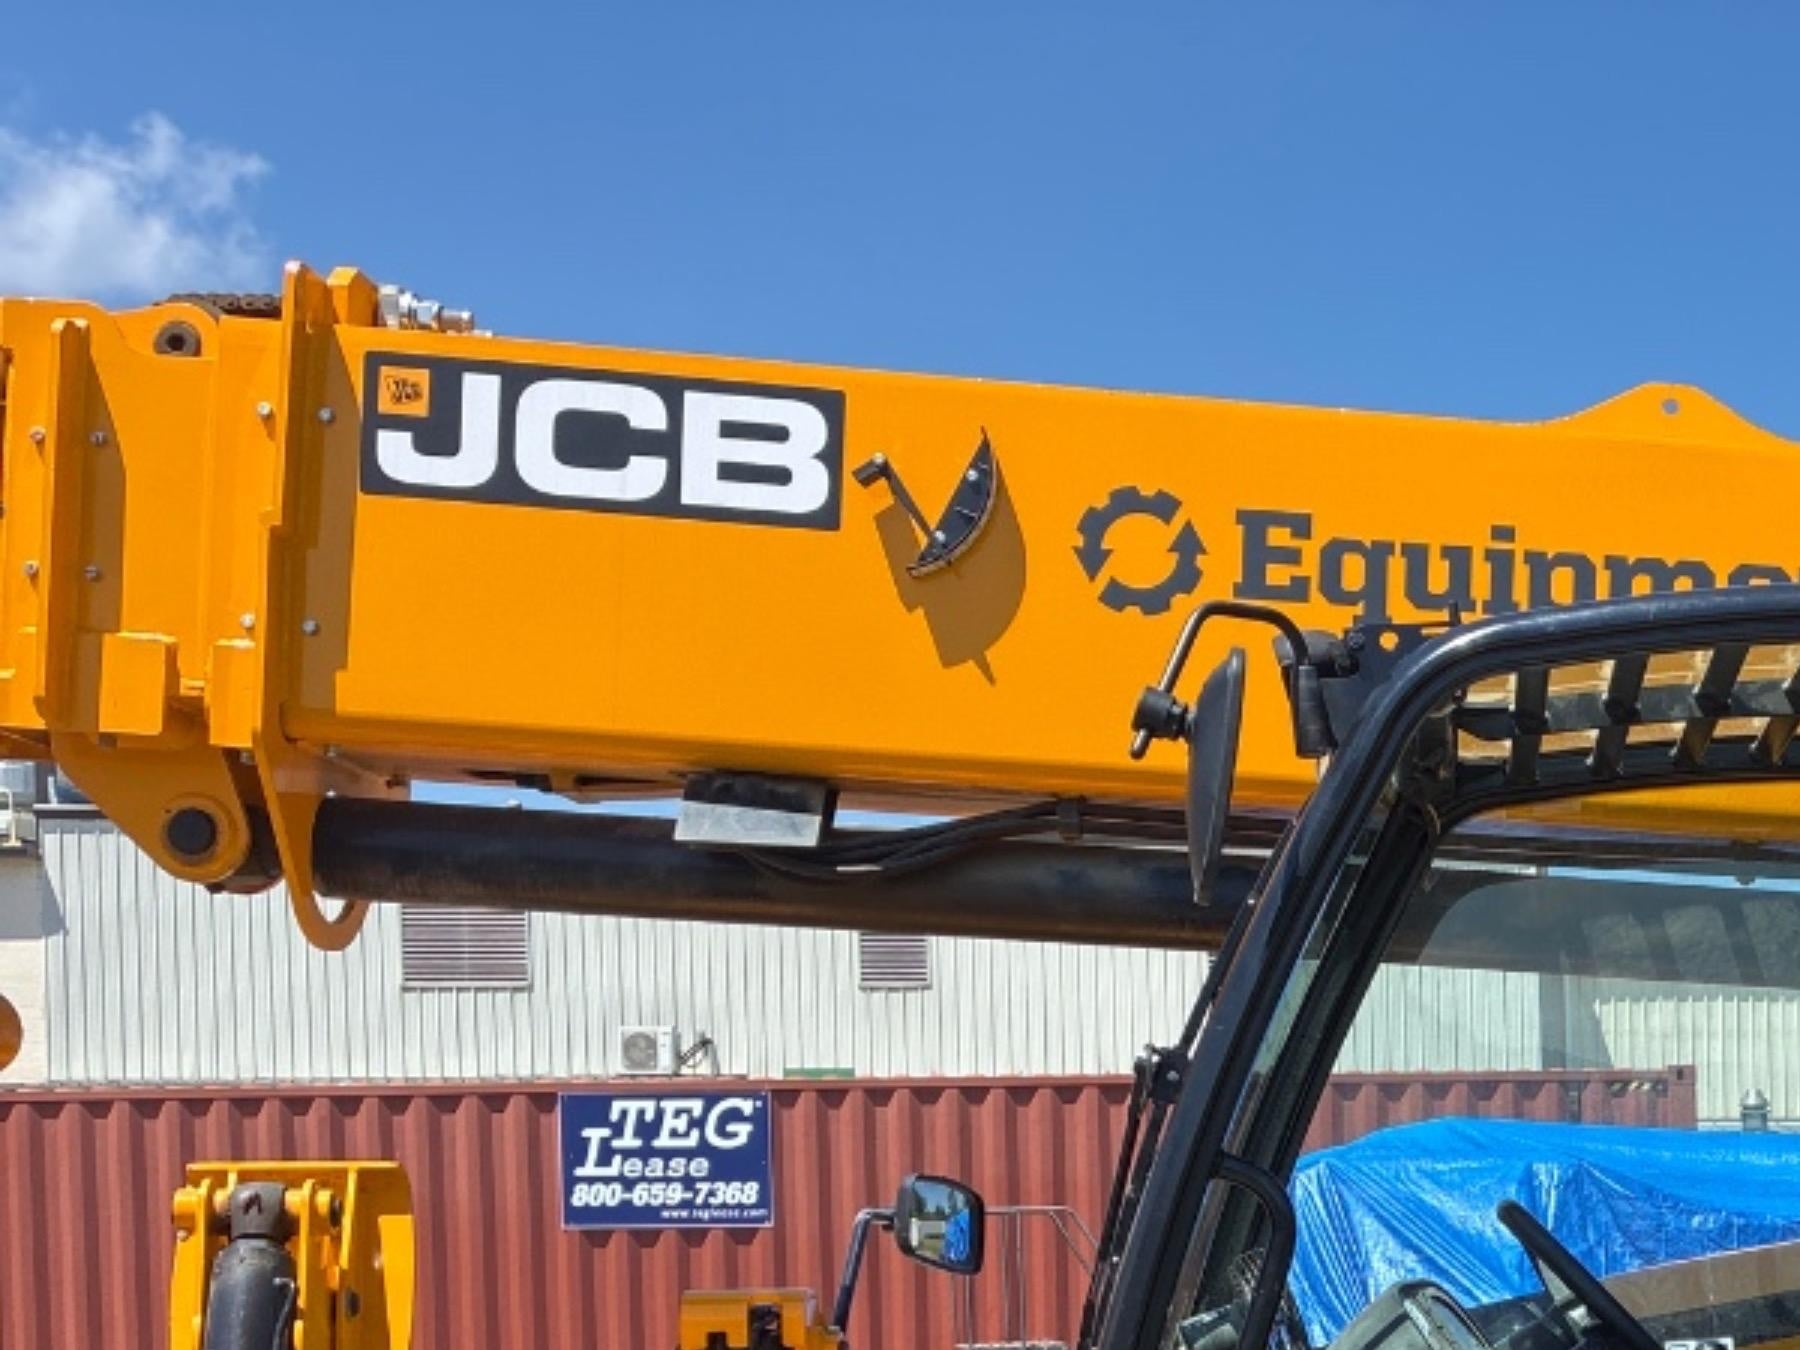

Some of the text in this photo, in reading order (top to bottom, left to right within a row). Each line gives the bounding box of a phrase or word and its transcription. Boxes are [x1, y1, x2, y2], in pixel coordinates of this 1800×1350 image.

[376, 371, 830, 515] JCB
[609, 1098, 755, 1149] TEG
[573, 1127, 710, 1177] Lease
[571, 1180, 760, 1207] 800-659-7368
